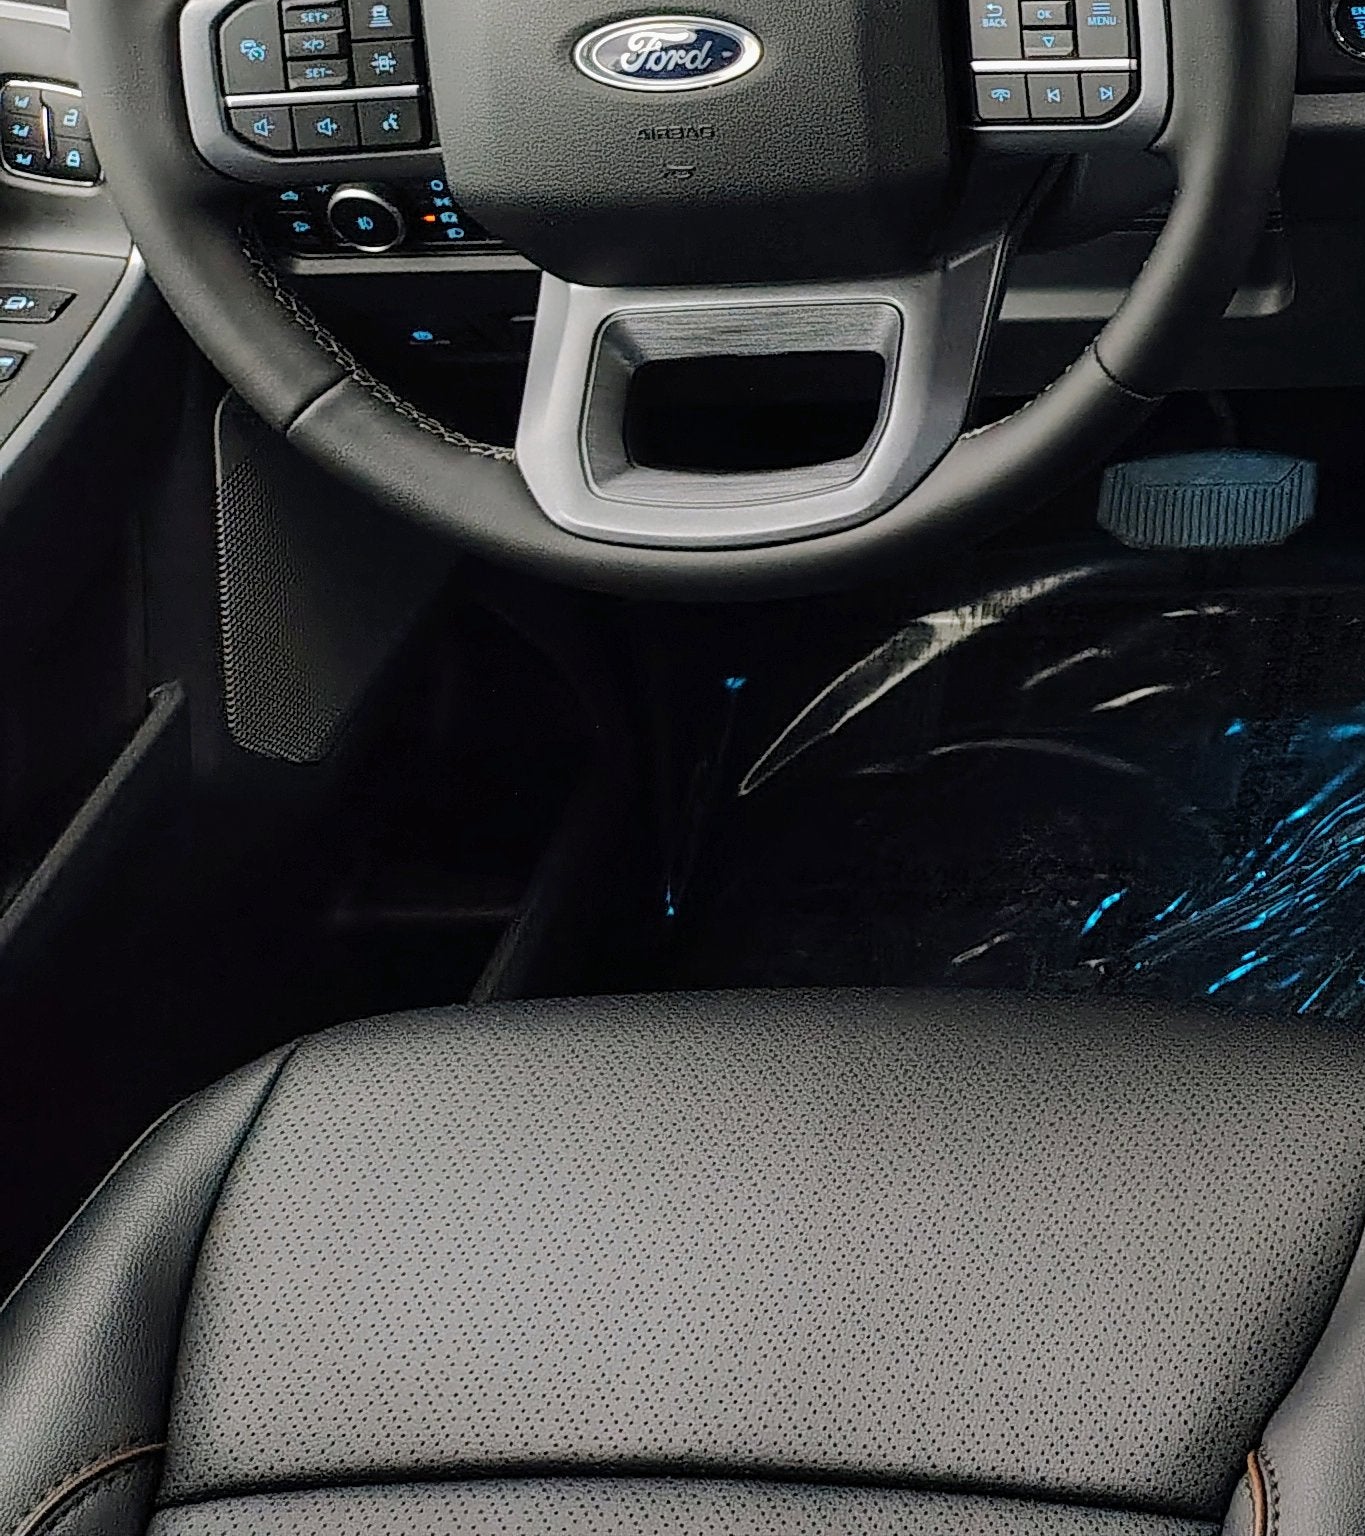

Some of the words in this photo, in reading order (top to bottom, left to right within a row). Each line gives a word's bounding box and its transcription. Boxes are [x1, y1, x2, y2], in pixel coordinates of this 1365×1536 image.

[300, 12, 329, 23] SET+
[1036, 10, 1052, 19] OK
[982, 19, 1007, 28] BACK
[1087, 17, 1117, 26] MENU
[620, 27, 714, 73] Ford
[637, 126, 716, 141] AIRBAG
